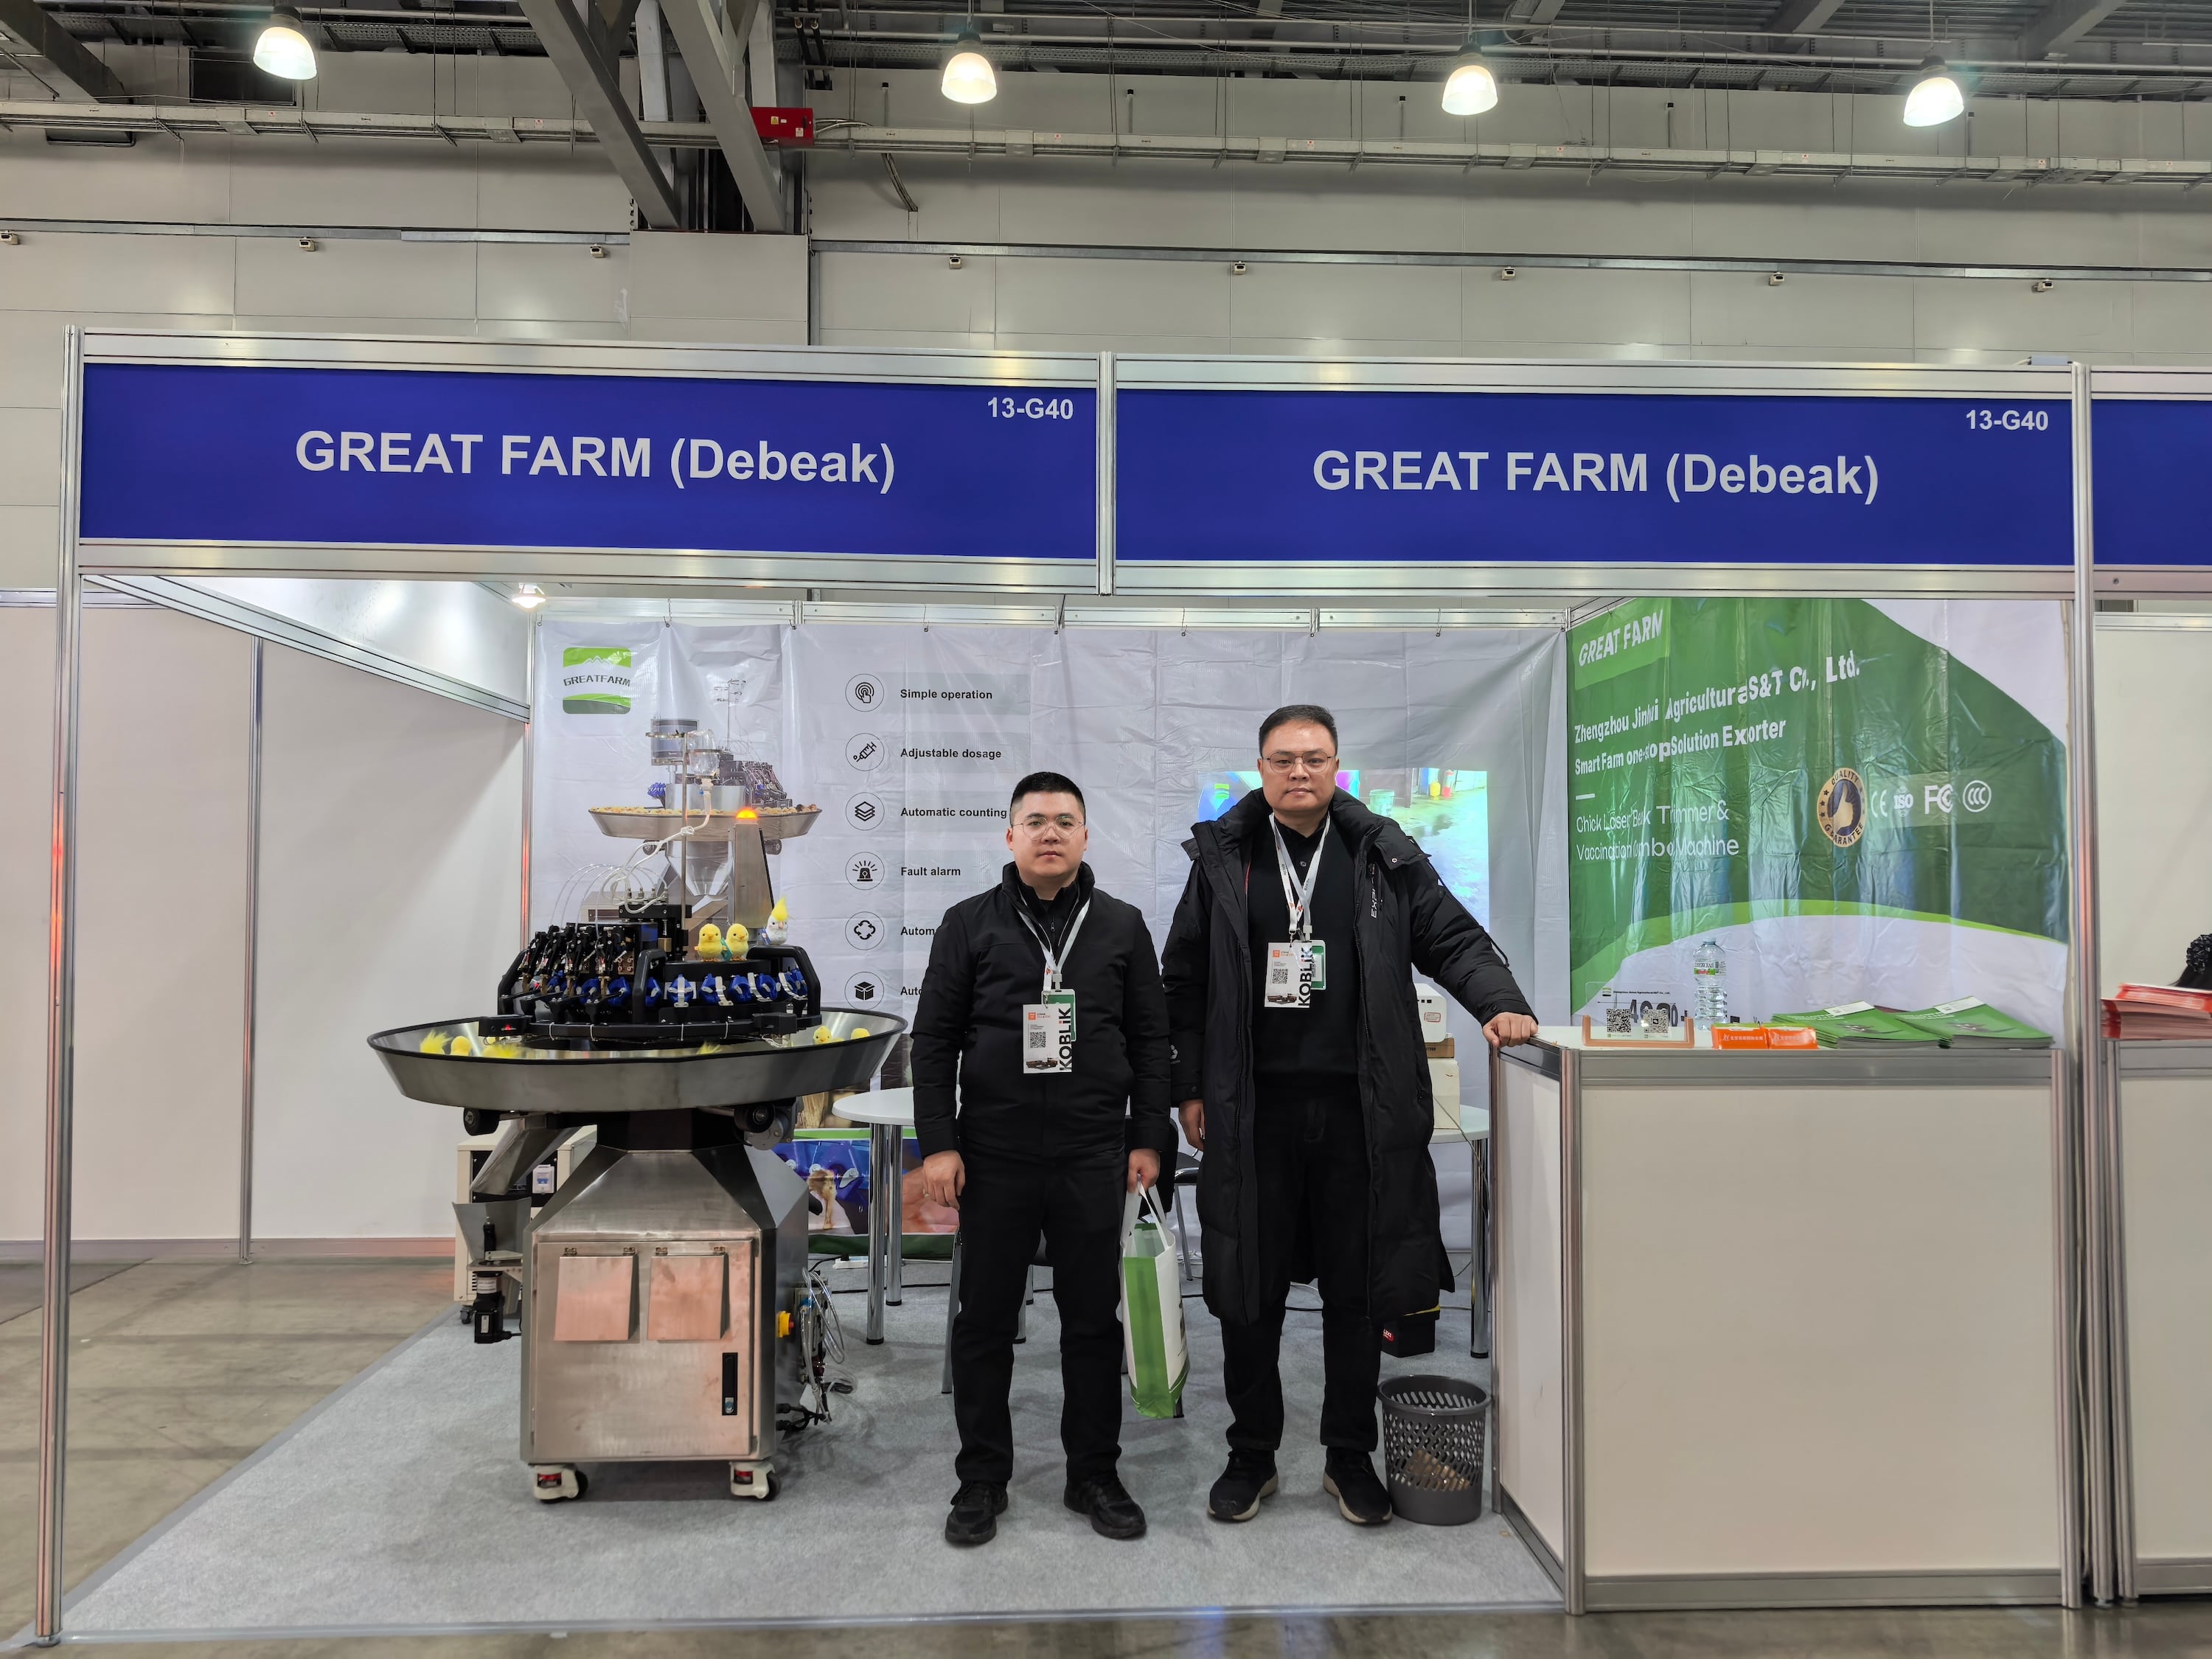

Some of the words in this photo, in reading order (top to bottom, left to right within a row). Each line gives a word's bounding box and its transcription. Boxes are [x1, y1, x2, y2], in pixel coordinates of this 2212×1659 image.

[987, 397, 1074, 420] 13-G40
[1966, 409, 2048, 431] 13-G40
[296, 430, 484, 474] GREAT
[501, 435, 650, 477] FARM
[670, 438, 894, 494] (Debeak)
[1313, 450, 1489, 490] GREAT
[1507, 452, 1647, 492] FARM
[1666, 453, 1878, 505] (Debeak)
[1579, 627, 1621, 667] GREAT
[1623, 608, 1664, 650] FARM
[563, 675, 630, 686] GREATFARM
[900, 689, 938, 700] Simple
[941, 689, 992, 701] operation
[1574, 714, 1630, 744] Zhengzhou
[1748, 669, 1783, 701] S&T
[1826, 650, 1860, 684] Ltd.
[900, 748, 959, 759] Adjustable
[961, 748, 1002, 760] dosage
[1575, 757, 1600, 776] Smart
[1601, 752, 1624, 771] Farm
[1671, 729, 1719, 756] Solution
[1831, 770, 1860, 786] QUALITY
[900, 807, 956, 817] Automatic
[959, 807, 1007, 819] counting
[1871, 789, 1888, 818] CE
[1893, 796, 1914, 810] ISO
[1576, 815, 1601, 834] Chick
[1603, 813, 1630, 831] Laser
[1656, 804, 1713, 825] Trimmer
[1717, 799, 1730, 821] &
[1675, 836, 1739, 857] Machine
[901, 866, 928, 876] Fault
[931, 866, 961, 876] alarm
[900, 926, 937, 936] Autom
